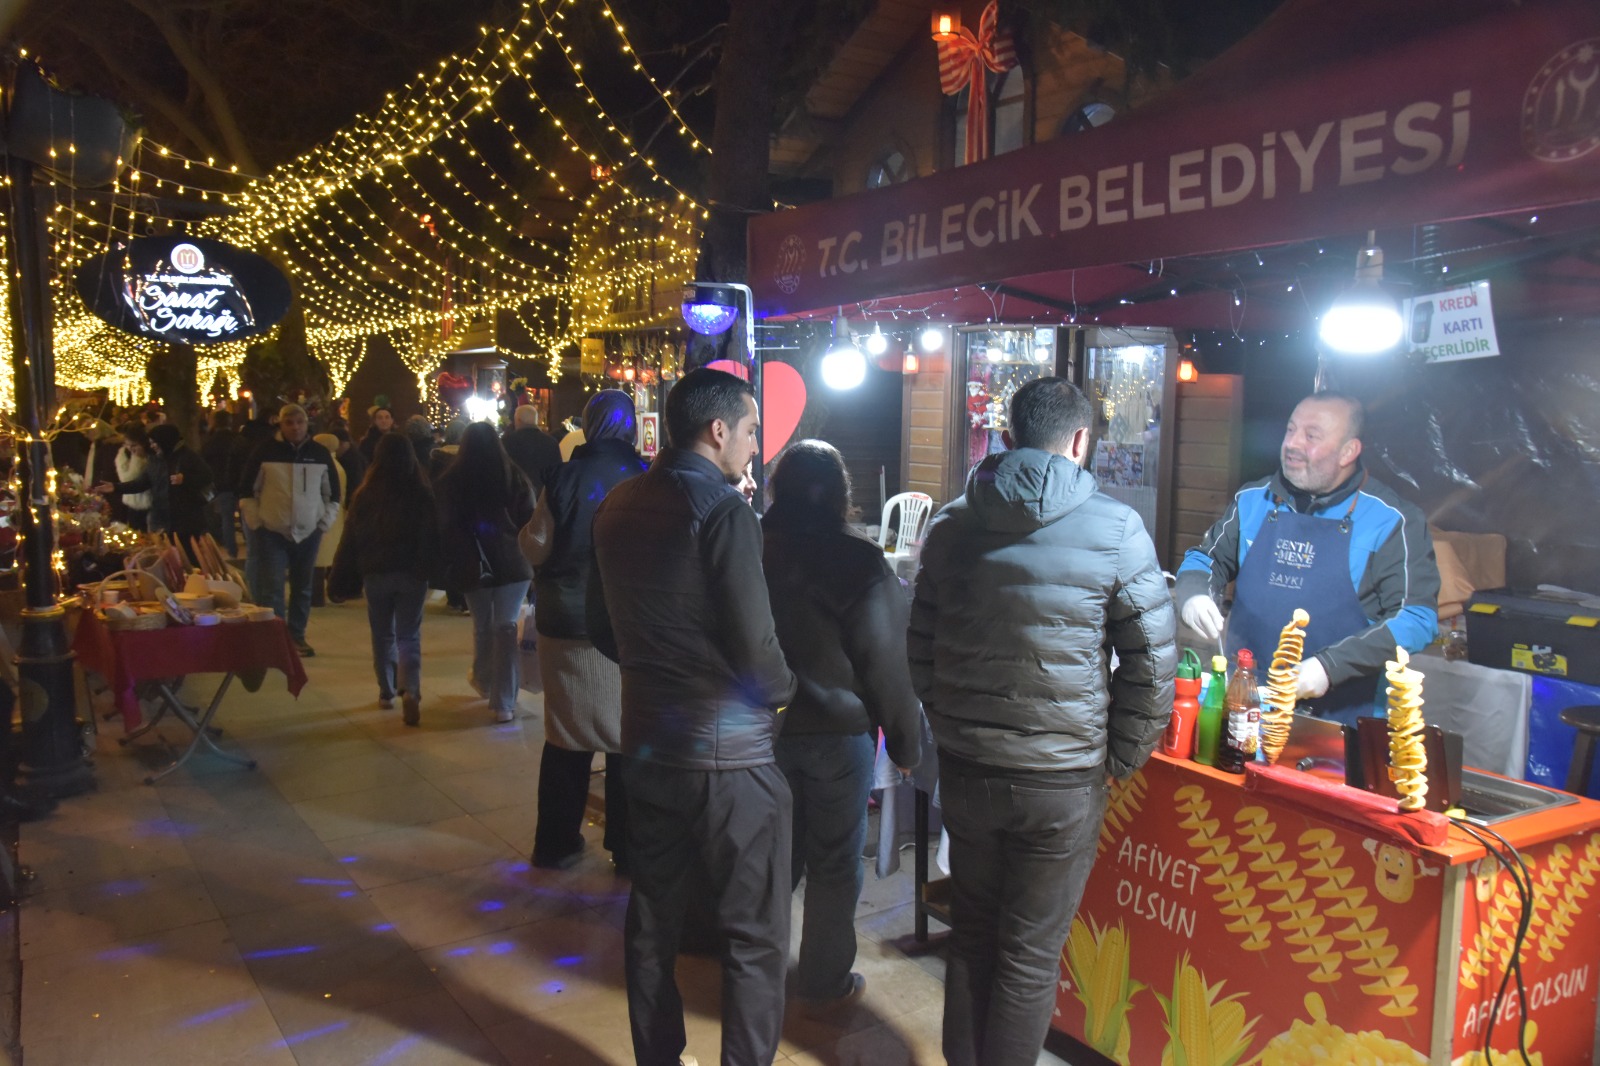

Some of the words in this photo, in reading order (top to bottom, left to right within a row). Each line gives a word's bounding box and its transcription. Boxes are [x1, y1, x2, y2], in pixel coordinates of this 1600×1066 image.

[818, 231, 868, 278] T.C.
[880, 183, 1043, 267] BİLECİK
[1059, 90, 1471, 232] BELEDİYESİ
[140, 285, 226, 310] Sanat
[1439, 291, 1478, 312] KREDİ
[150, 307, 239, 337] Sokağı
[1443, 317, 1483, 335] KARTI
[1422, 337, 1491, 361] EÇERLİDİR
[1269, 572, 1304, 587] SAYKI
[1117, 835, 1201, 896] AFİYET
[1116, 878, 1197, 939] OLSUN
[1530, 964, 1589, 1011] OLSUN
